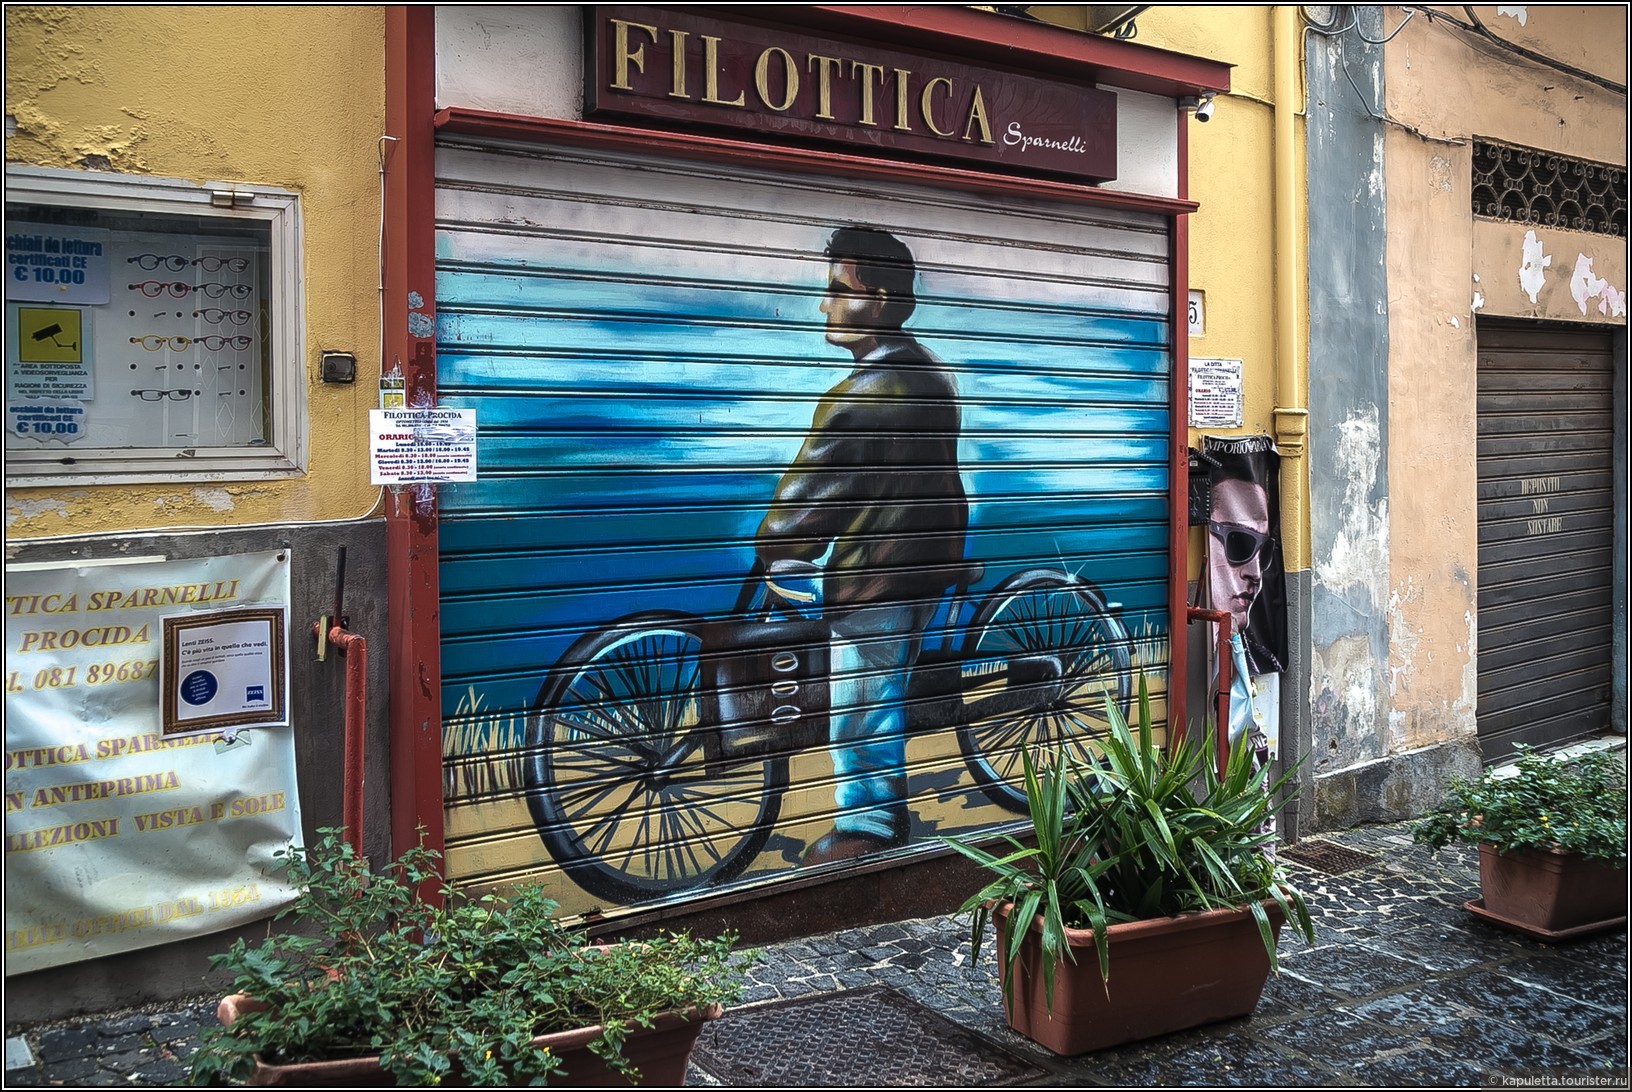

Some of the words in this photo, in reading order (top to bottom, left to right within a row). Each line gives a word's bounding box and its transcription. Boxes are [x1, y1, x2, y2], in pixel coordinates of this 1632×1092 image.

[609, 18, 995, 144] FILOTTICA
[1003, 121, 1087, 153] Sparnelli
[6, 233, 42, 253] chiali
[44, 236, 60, 253] da
[61, 237, 103, 257] lettura
[8, 253, 71, 268] certificati
[72, 255, 87, 269] CE
[14, 265, 29, 281] €
[32, 267, 85, 285] 10,00
[16, 421, 29, 433] €
[86, 579, 239, 611] SPARNELLI
[18, 624, 150, 653] PROCIDA
[192, 647, 202, 655] più
[221, 643, 241, 651] quello
[6, 672, 23, 692] l.
[34, 666, 77, 689] 081
[32, 771, 180, 808] ANTEPRIMA
[134, 806, 202, 832] VISTA
[210, 802, 225, 820] E
[231, 792, 285, 818] SOLE
